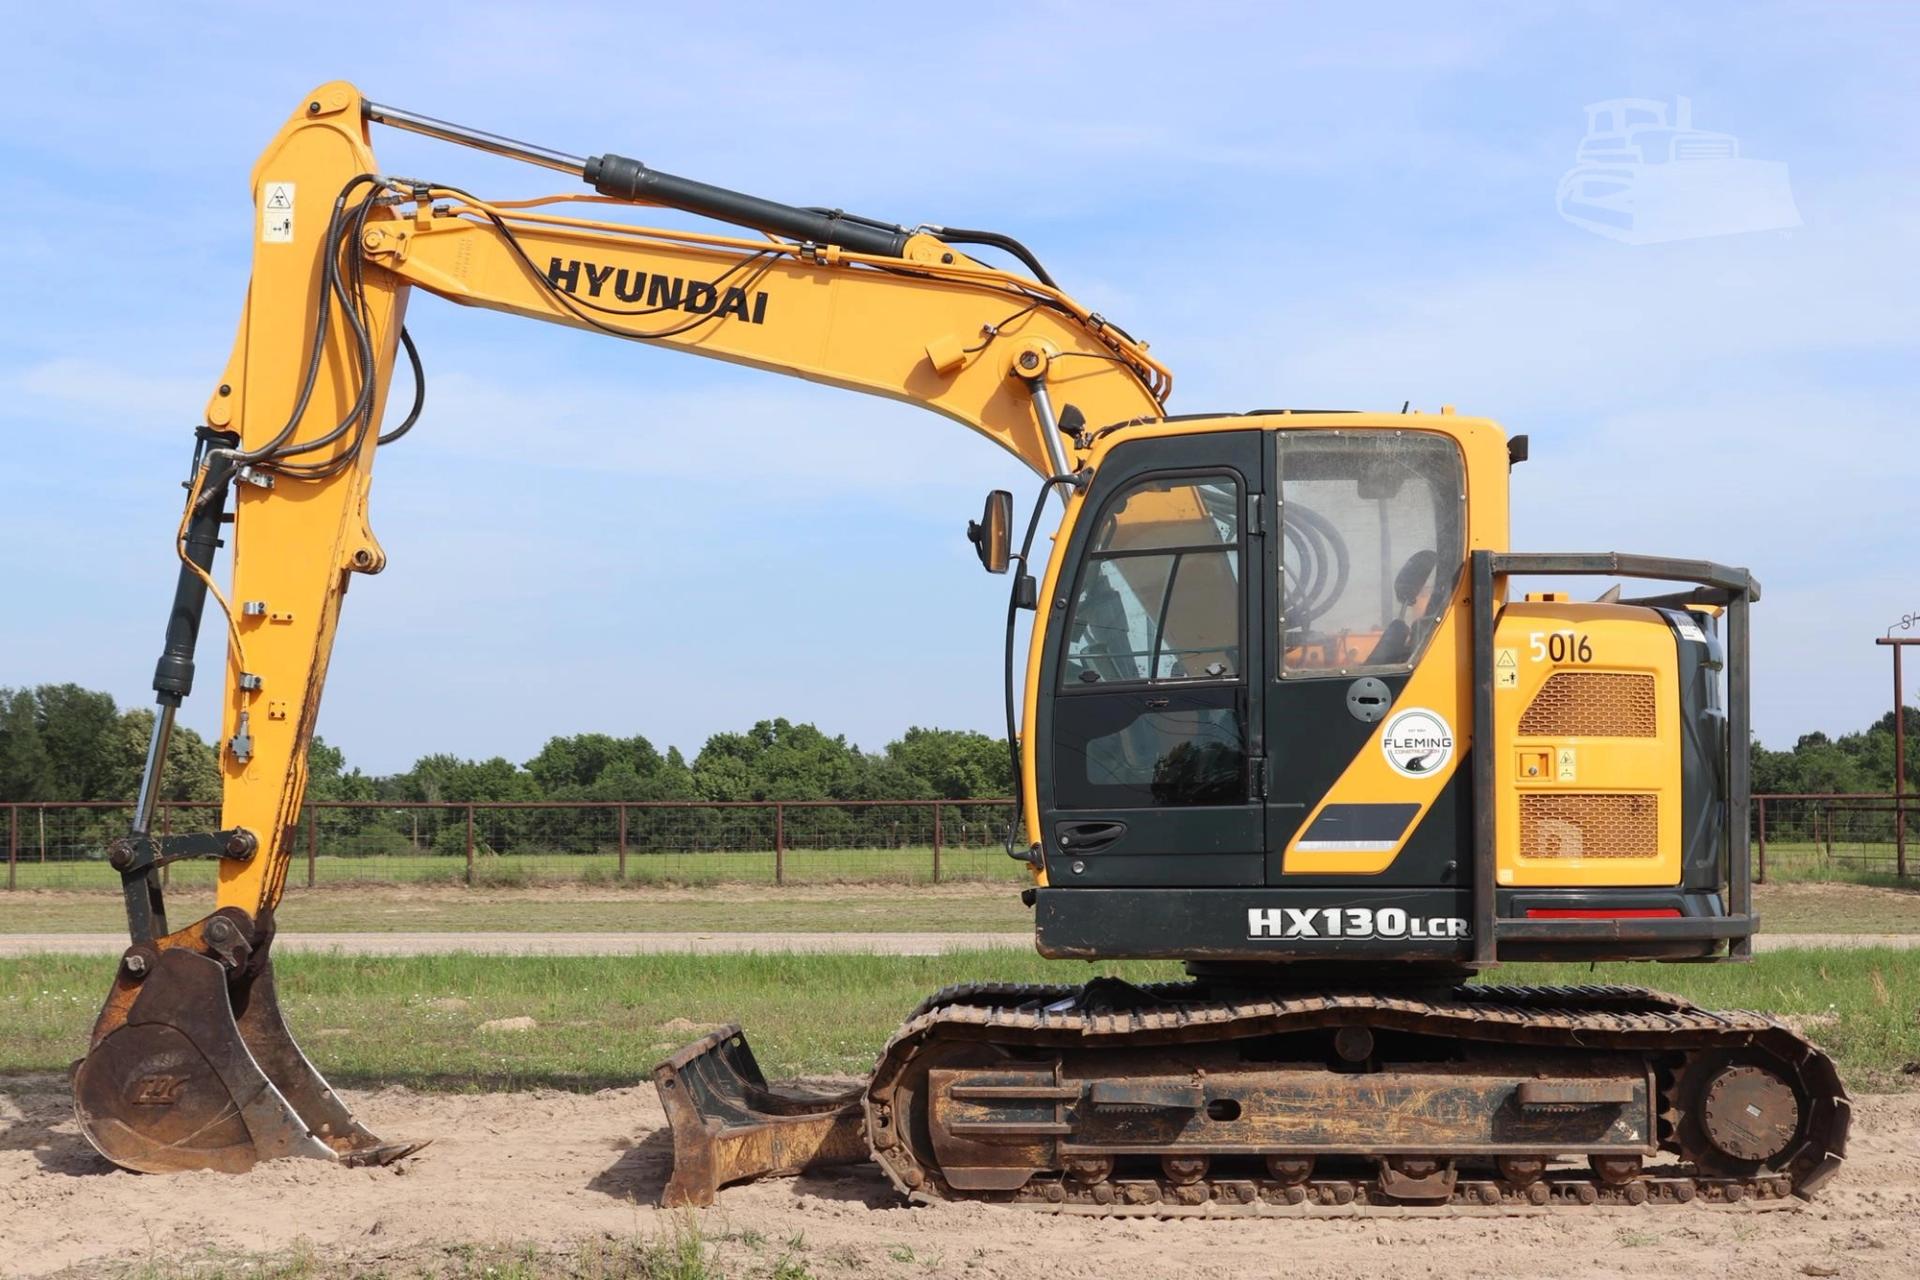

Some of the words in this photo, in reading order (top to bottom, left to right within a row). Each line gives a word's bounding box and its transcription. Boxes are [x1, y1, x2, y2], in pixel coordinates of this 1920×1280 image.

[548, 257, 768, 324] HYUNDAI
[1530, 632, 1592, 663] 5016
[1384, 738, 1452, 748] FLEMING
